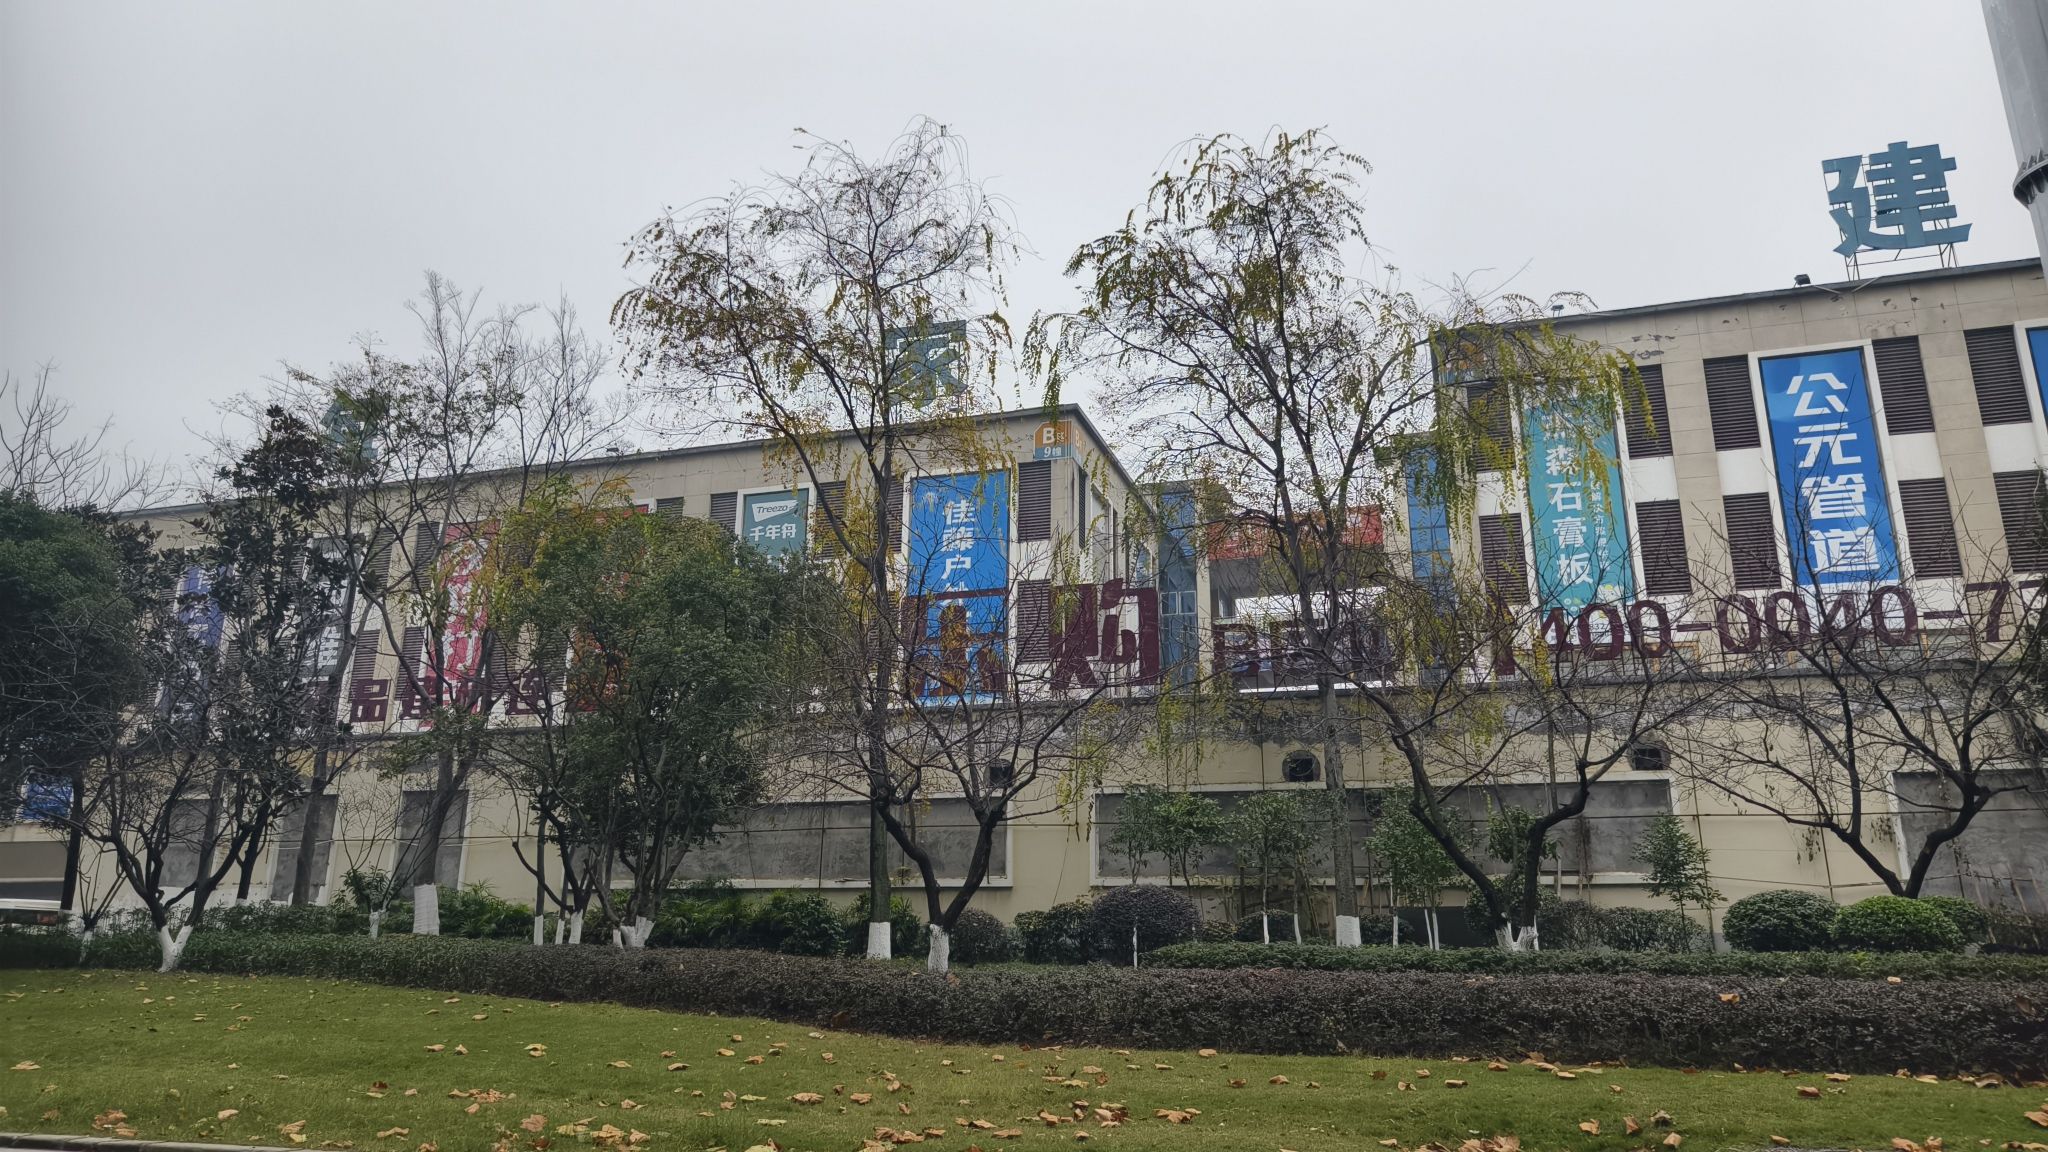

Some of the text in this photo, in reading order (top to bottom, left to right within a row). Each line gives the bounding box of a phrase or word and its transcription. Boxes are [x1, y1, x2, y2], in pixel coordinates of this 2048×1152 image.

[1822, 141, 1972, 258] 建
[1787, 372, 1880, 573] 公元管道
[749, 523, 797, 541] 千年舟
[756, 505, 788, 514] Treezo
